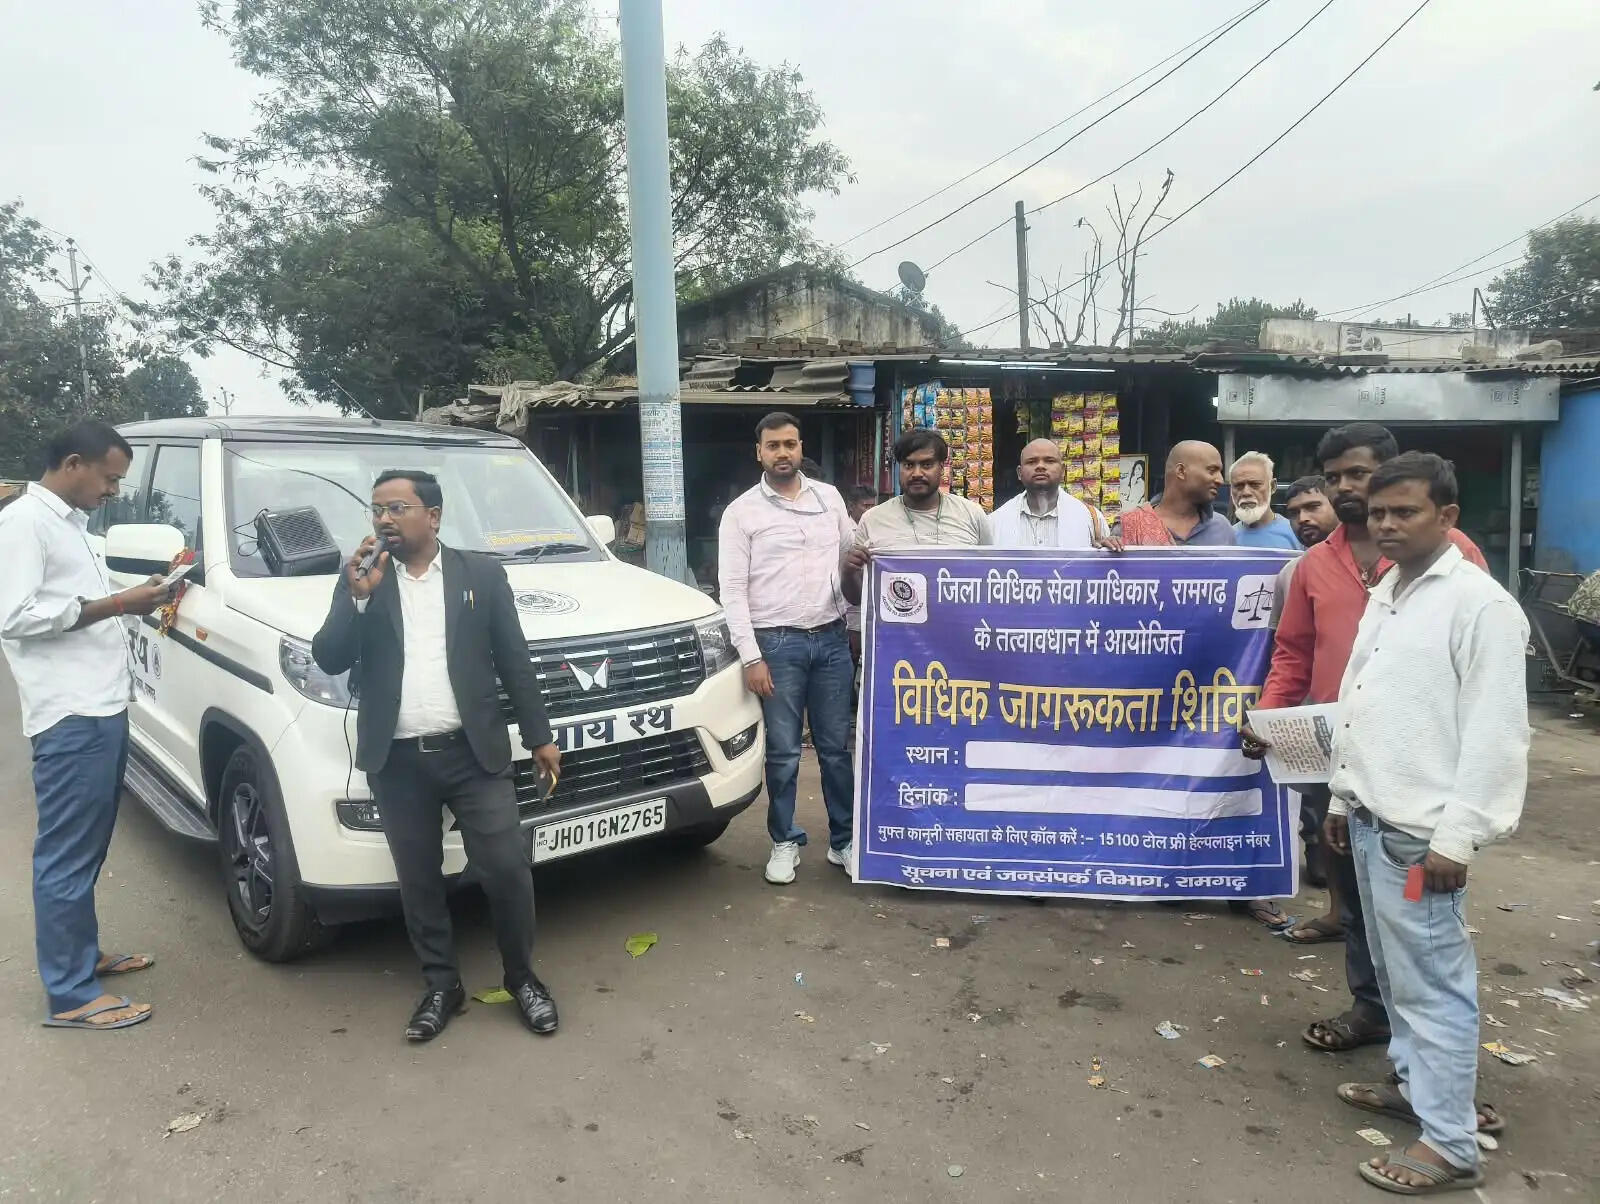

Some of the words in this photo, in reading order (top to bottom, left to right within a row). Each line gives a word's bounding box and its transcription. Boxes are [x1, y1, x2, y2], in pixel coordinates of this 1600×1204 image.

[937, 568, 982, 603] जिला
[987, 569, 1043, 604] विधिक
[1047, 569, 1082, 605] सेवा
[1086, 569, 1164, 612] प्राधिकार,
[1172, 579, 1228, 612] रामगढ़
[974, 618, 991, 650] के
[996, 628, 1081, 654] तत्वावधान
[1086, 620, 1099, 654] में
[1105, 620, 1185, 655] आयोजित
[893, 659, 990, 726] विधिक
[999, 682, 1163, 733] जागरूकता
[550, 715, 617, 751] याय
[627, 704, 674, 736] रथ
[906, 746, 949, 764] स्थान
[898, 782, 948, 806] दिनांक
[548, 805, 664, 851] JH01GN2765
[908, 824, 942, 846] कानूनी
[946, 828, 989, 843] सहायता
[991, 825, 1003, 843] के
[1006, 825, 1028, 846] लिए
[1031, 827, 1056, 845] कॉल
[1059, 828, 1077, 845] करें
[1099, 832, 1140, 847] 15100
[1142, 831, 1167, 849] टोल
[1170, 832, 1187, 850] फ्री
[1189, 833, 1242, 851] हेल्पलाइन
[1245, 831, 1271, 848] नंबर
[901, 865, 958, 884] सूचना
[963, 866, 992, 881] एवं
[996, 868, 1092, 884] जनसंपर्क
[1096, 870, 1170, 889] विभाग,
[1176, 876, 1248, 892] रामगढ़
